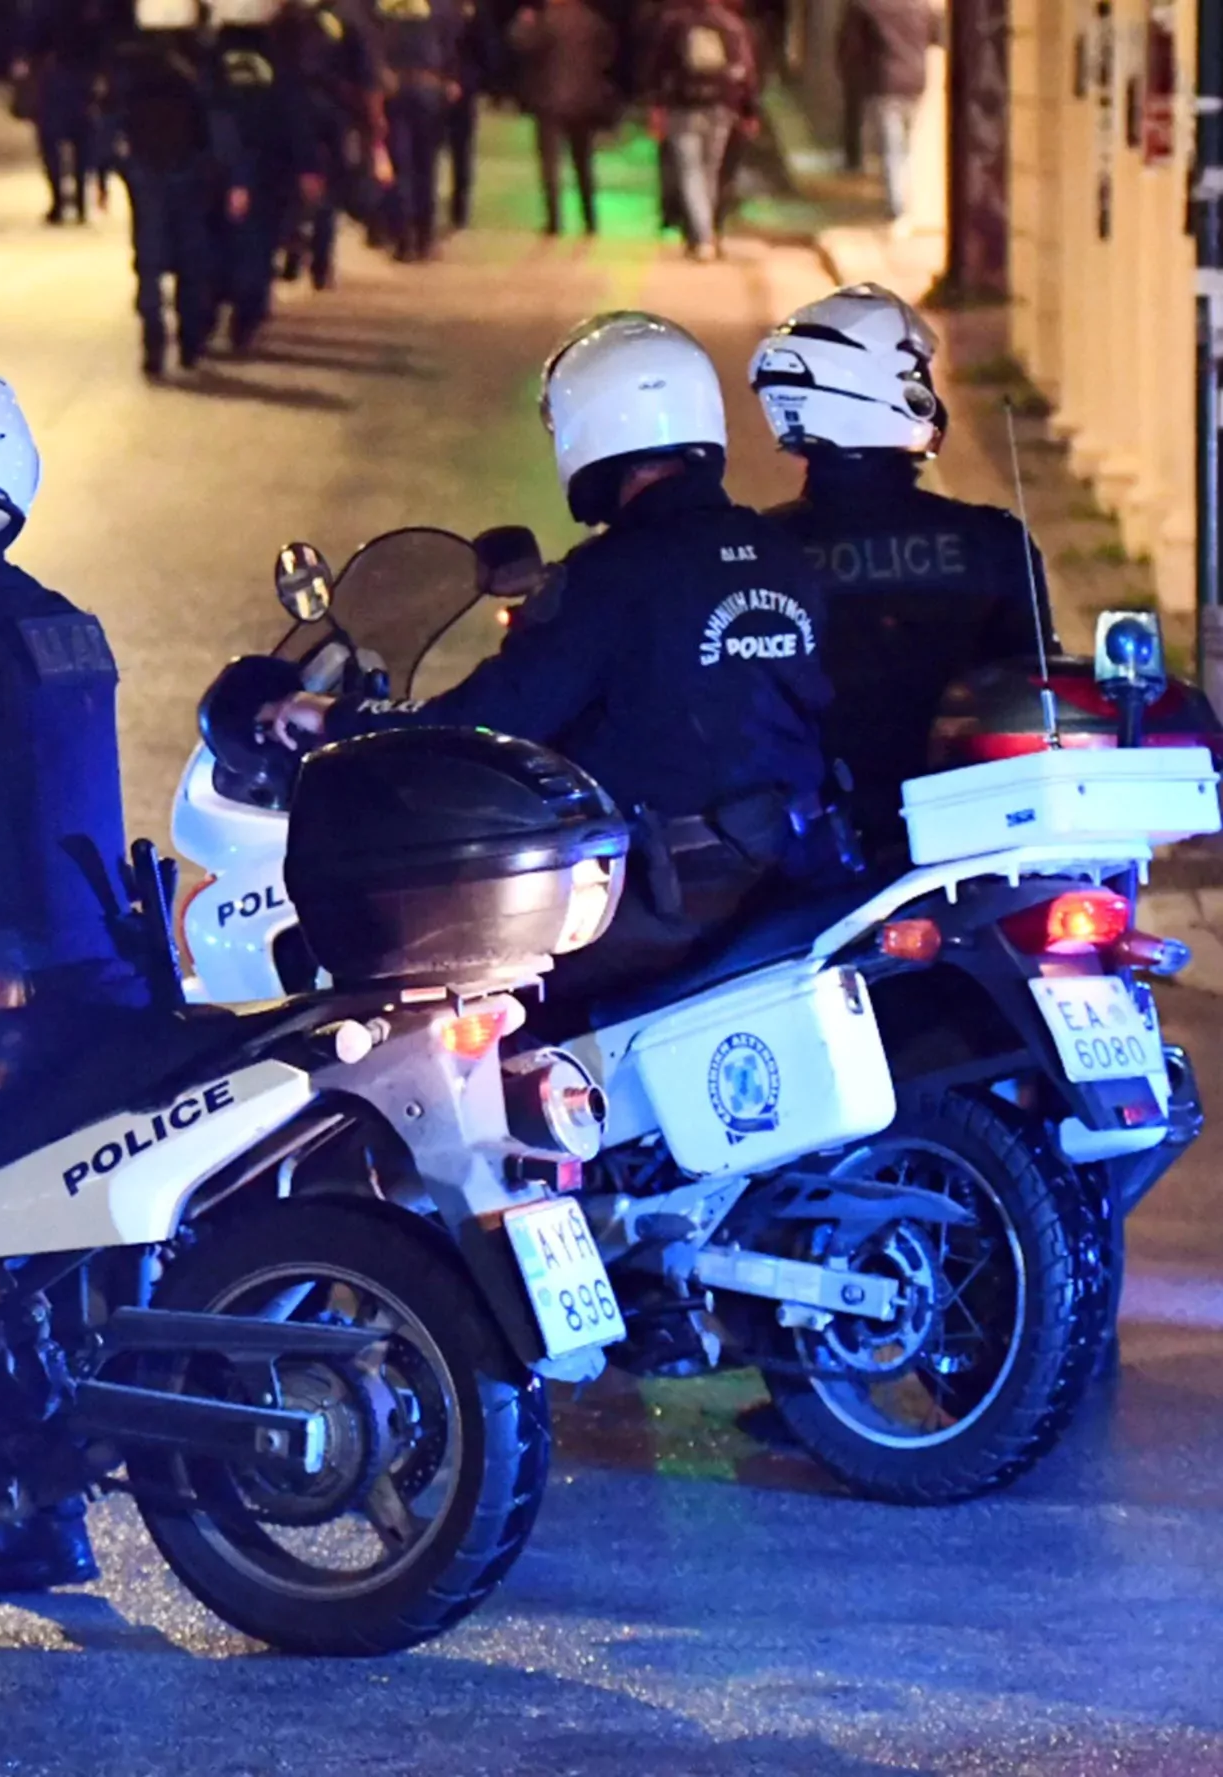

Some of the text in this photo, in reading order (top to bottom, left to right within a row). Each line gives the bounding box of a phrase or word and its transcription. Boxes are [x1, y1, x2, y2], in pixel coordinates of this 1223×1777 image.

[725, 634, 798, 660] POLICE
[217, 886, 285, 928] POL
[1058, 1001, 1104, 1032] EA
[1075, 1036, 1146, 1069] 6080
[62, 1080, 234, 1197] POLICE
[559, 1279, 615, 1332] 896
